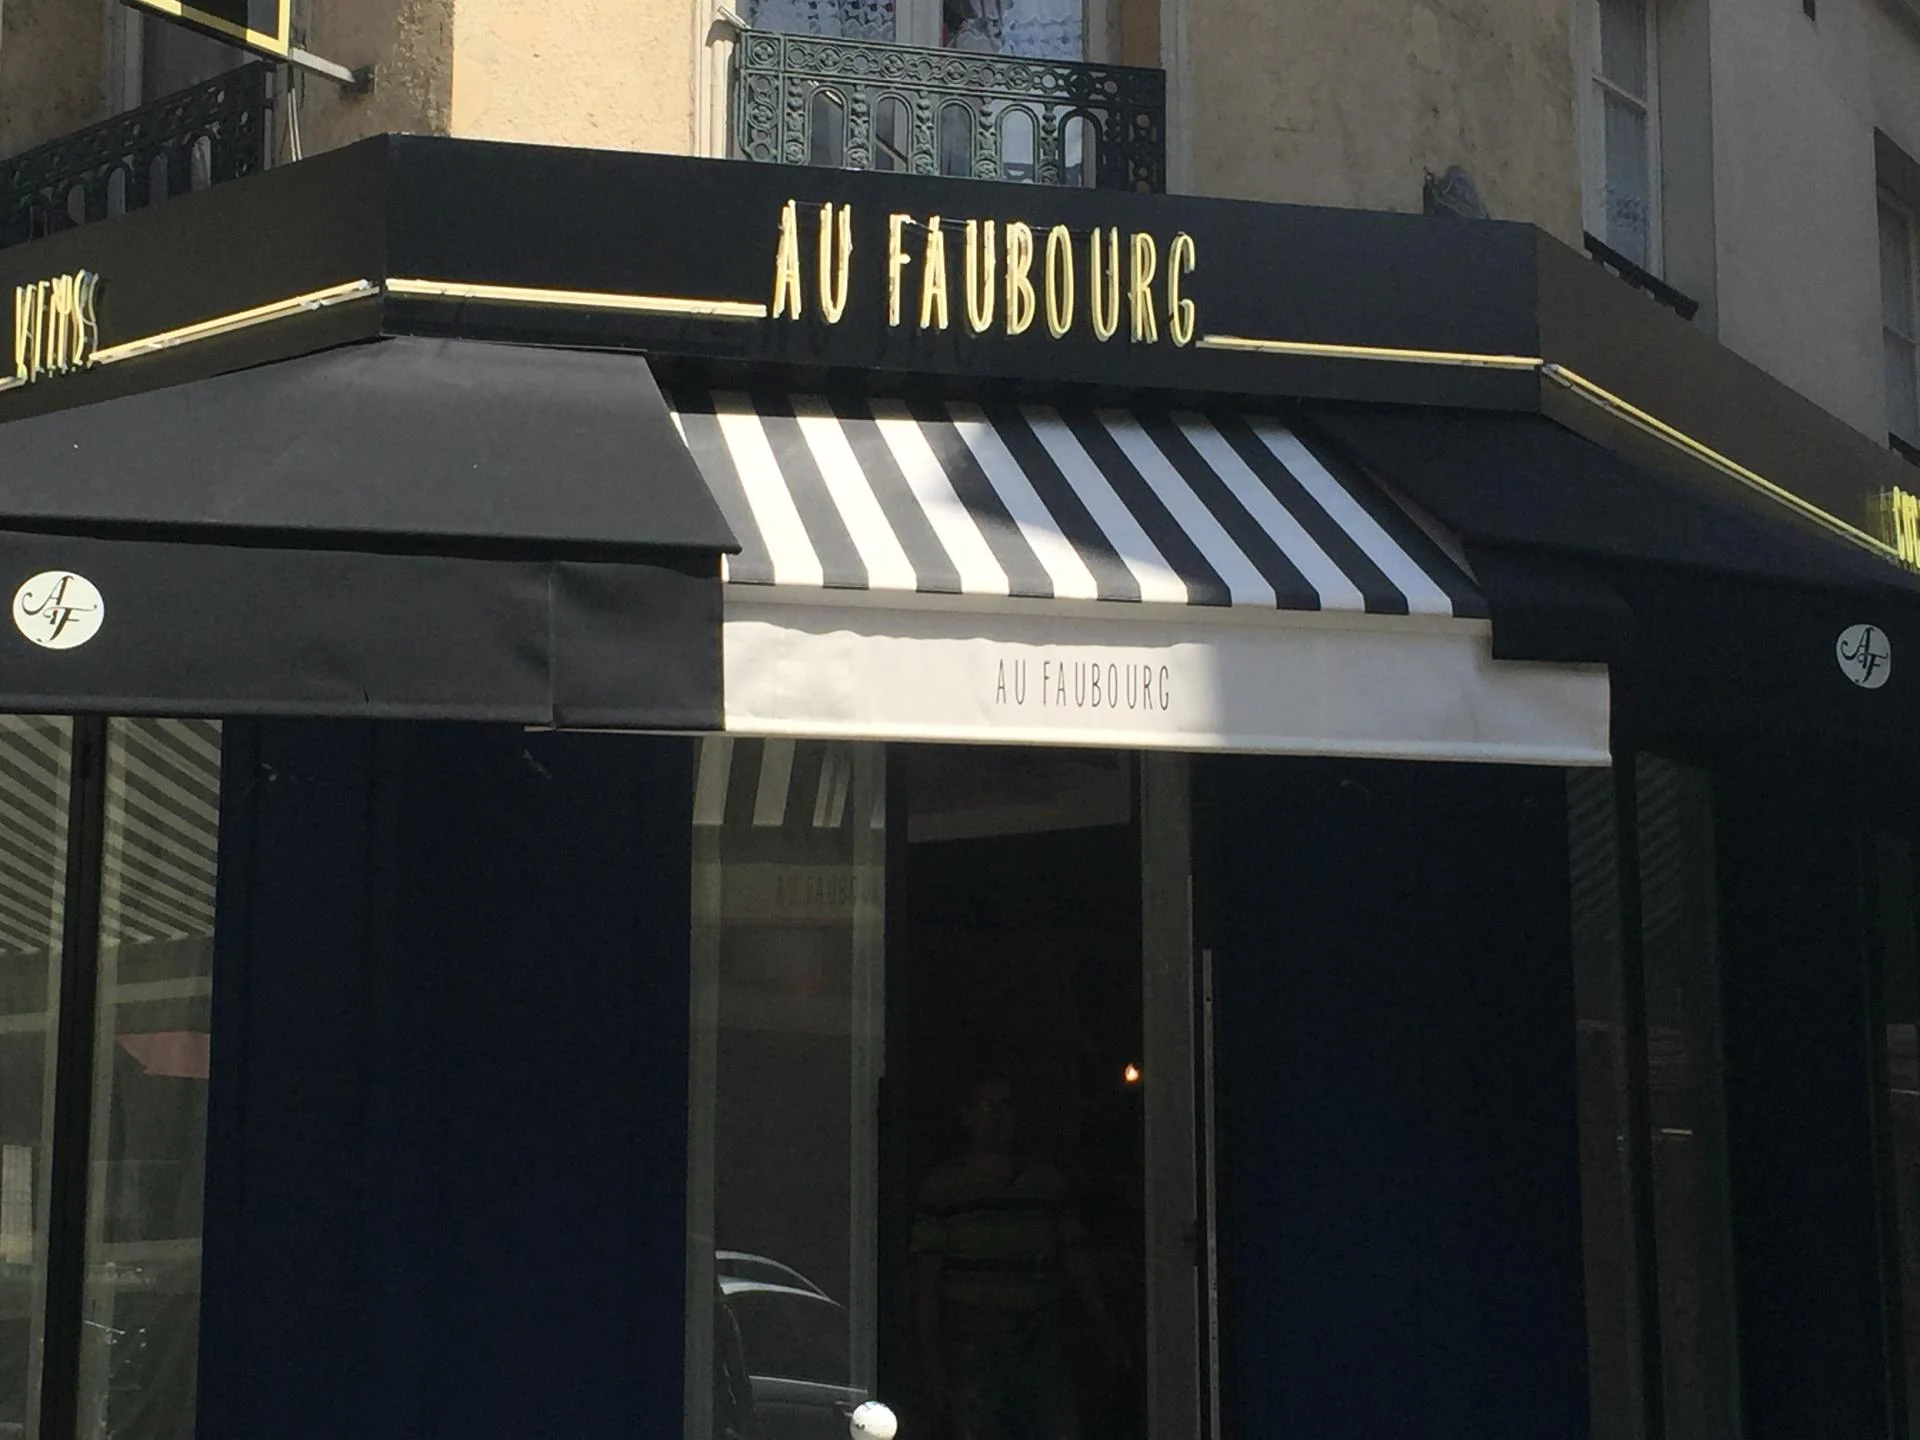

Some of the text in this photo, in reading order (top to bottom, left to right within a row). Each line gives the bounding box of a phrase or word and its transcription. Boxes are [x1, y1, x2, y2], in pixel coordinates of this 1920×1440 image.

[773, 198, 1197, 347] AU FAUBOURG
[996, 659, 1170, 711] AU FAUBOURG
